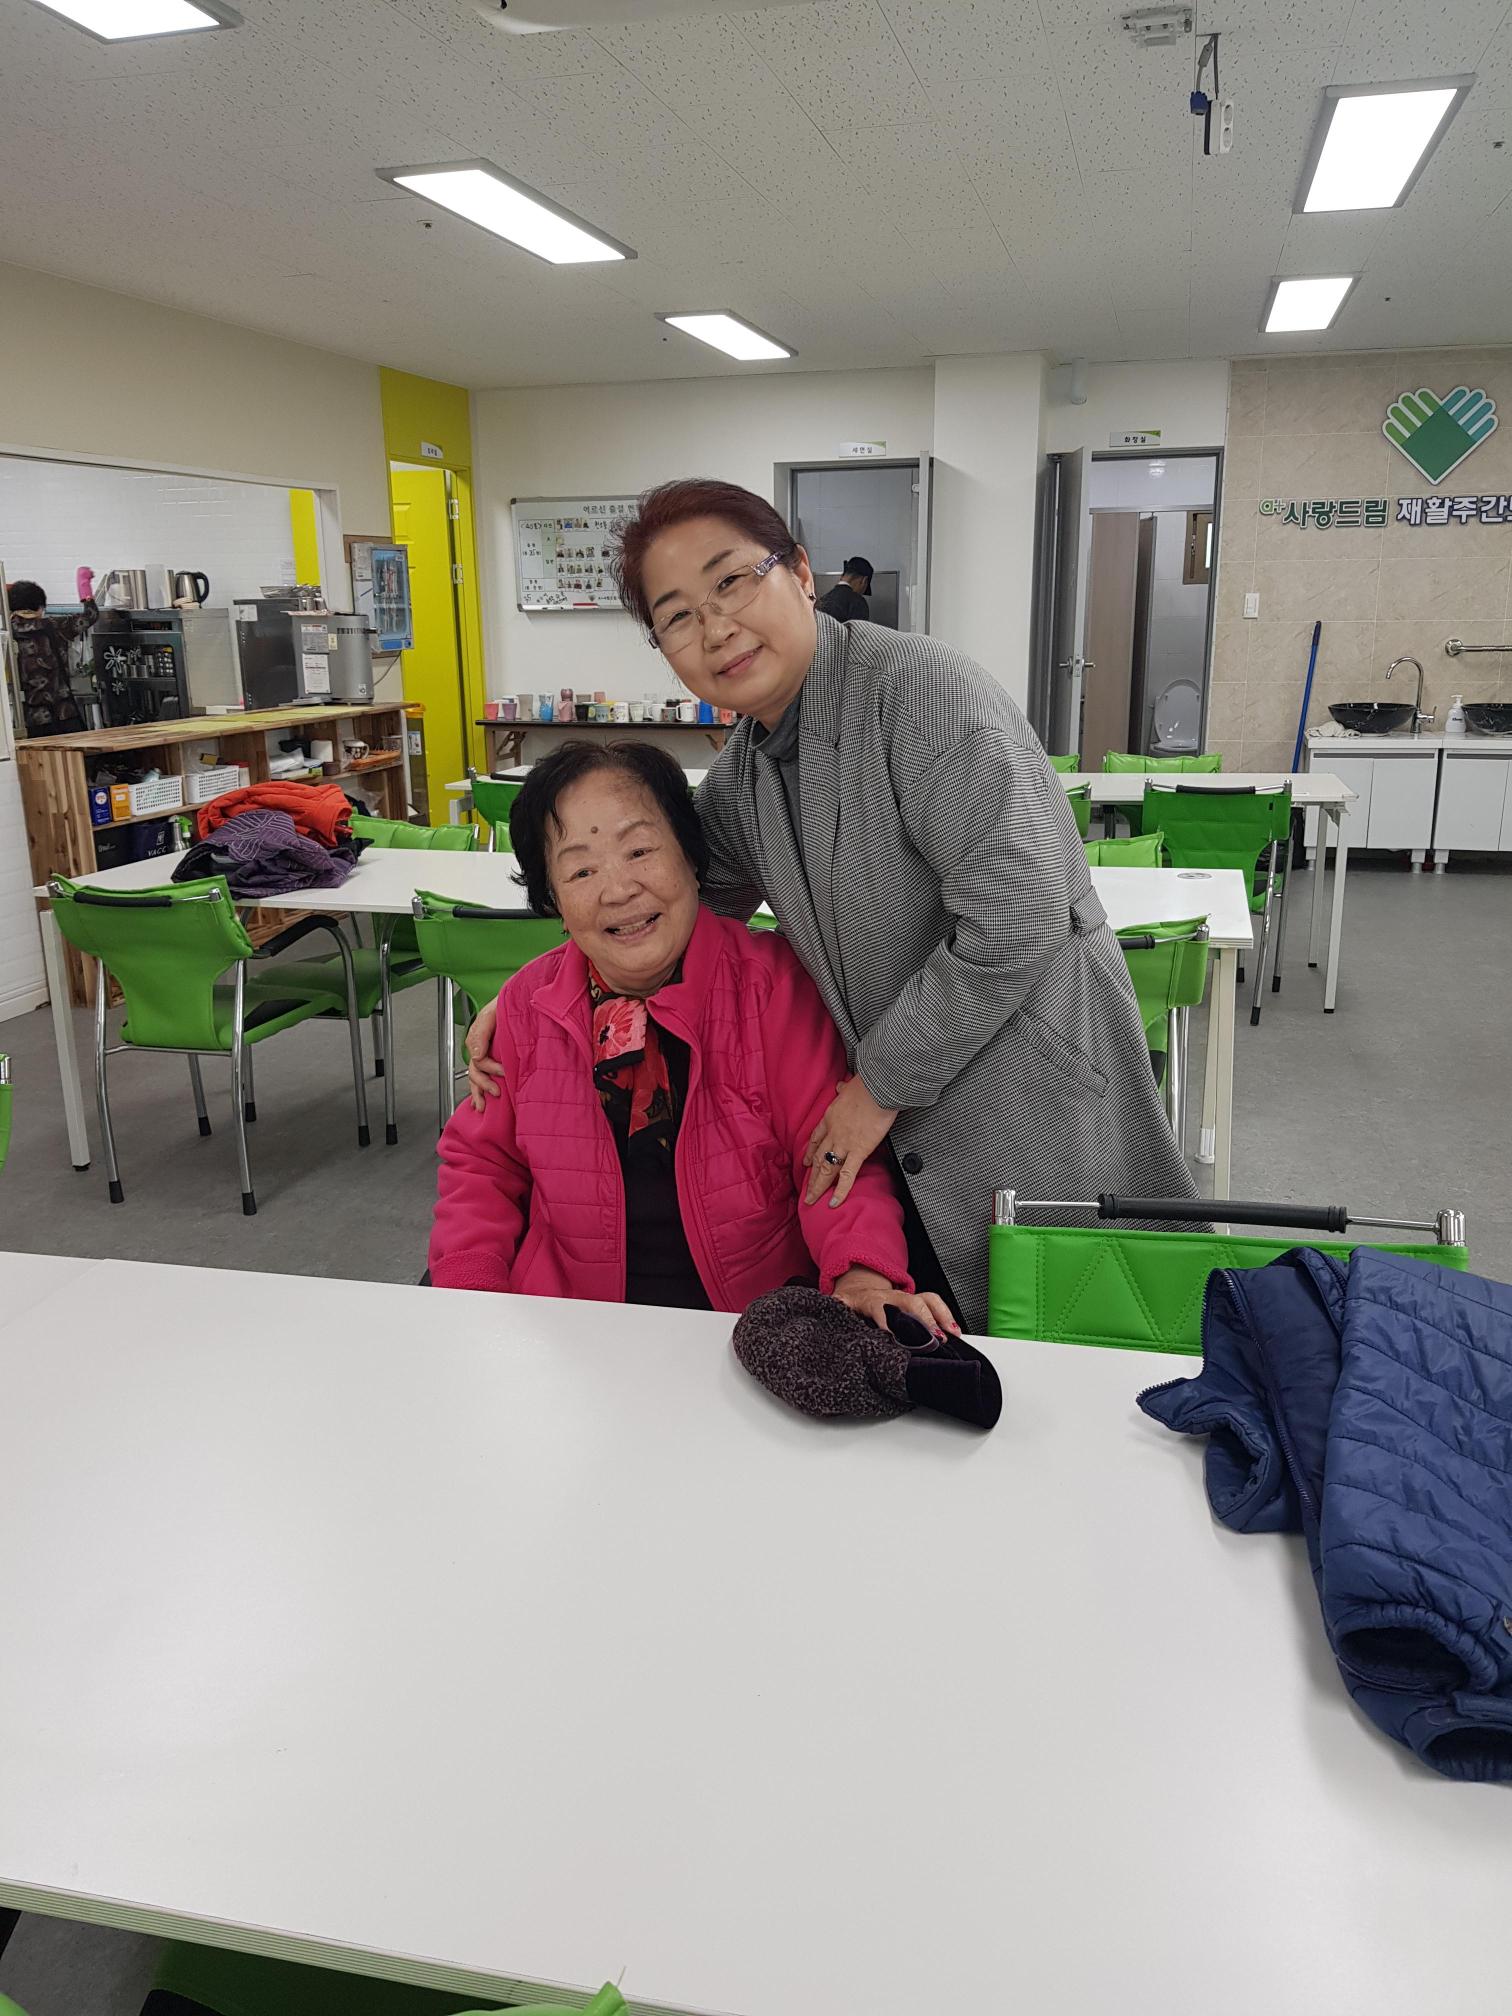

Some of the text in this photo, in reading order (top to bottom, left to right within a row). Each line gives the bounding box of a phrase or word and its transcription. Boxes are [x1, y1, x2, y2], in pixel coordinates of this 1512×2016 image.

[1124, 436, 1146, 444] 화장실
[583, 504, 606, 514] 어르신
[1396, 495, 1512, 526] 재활주간
